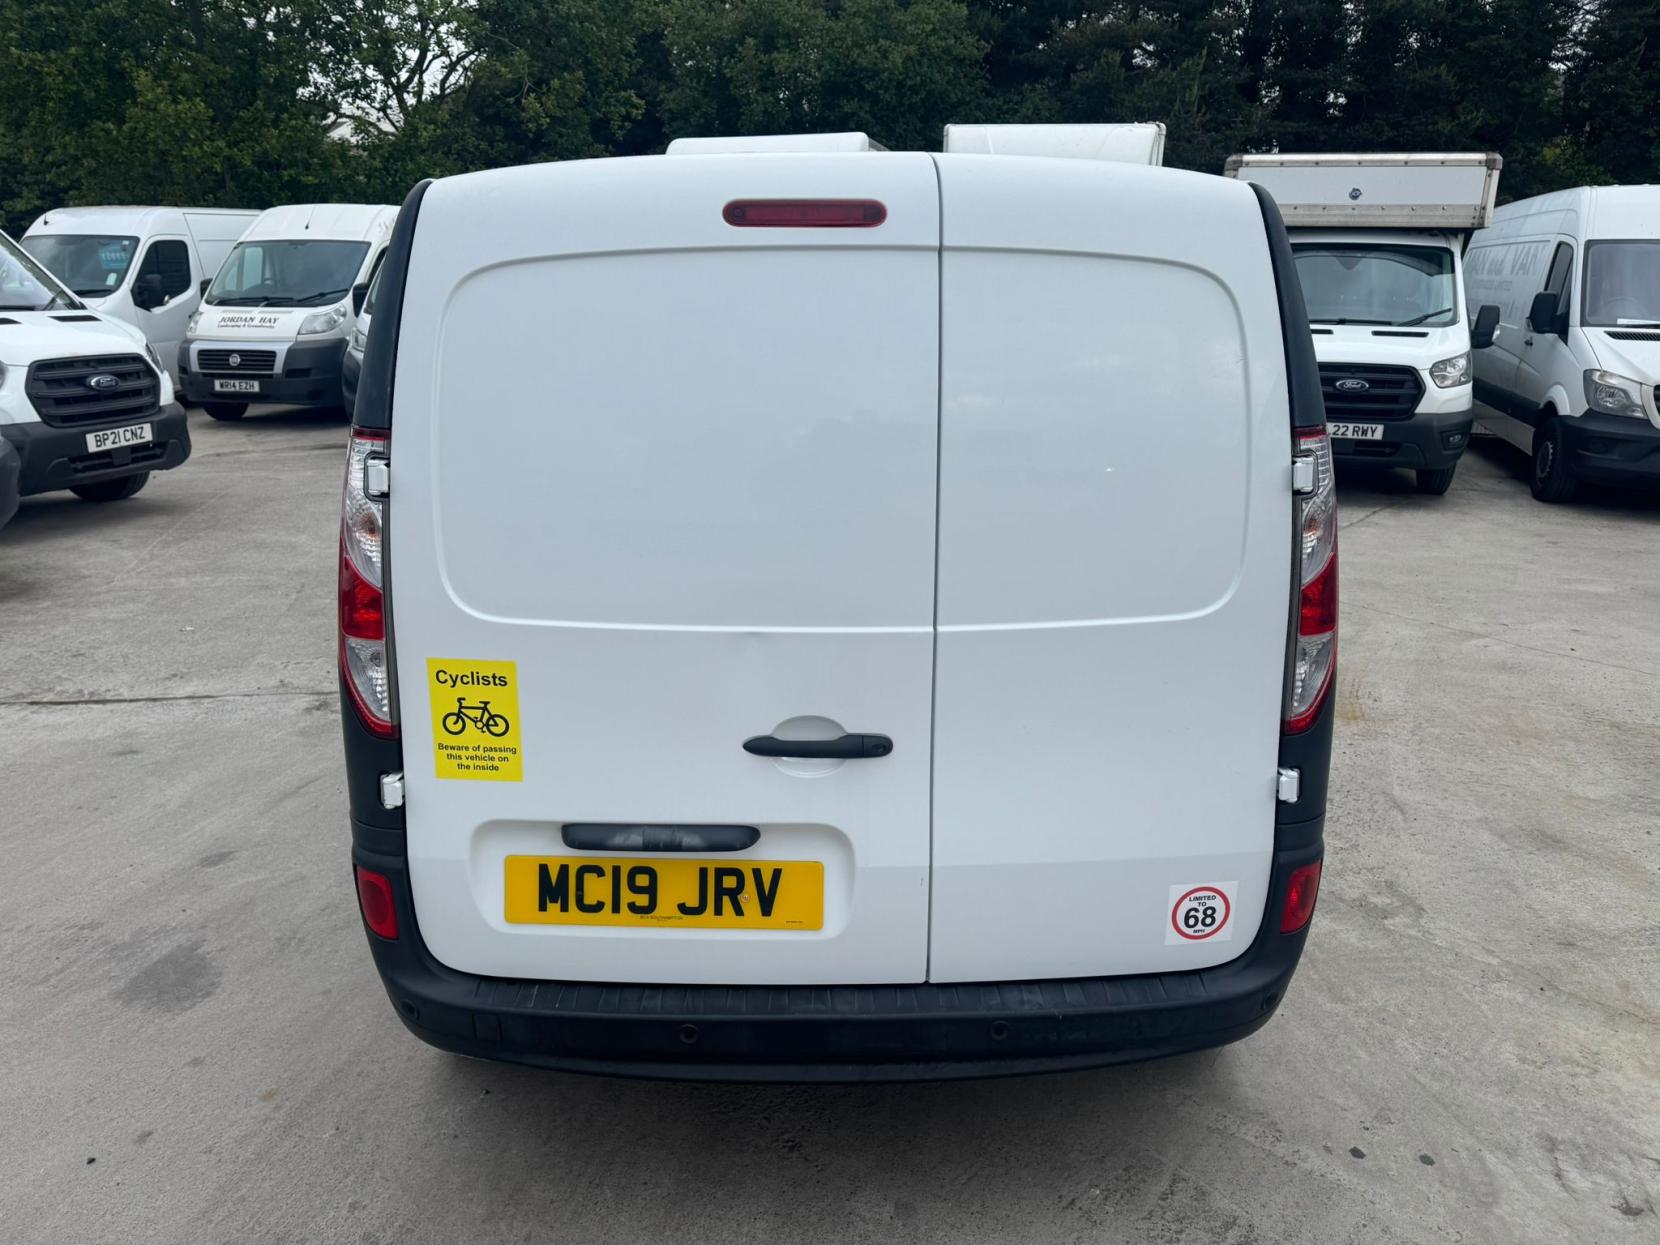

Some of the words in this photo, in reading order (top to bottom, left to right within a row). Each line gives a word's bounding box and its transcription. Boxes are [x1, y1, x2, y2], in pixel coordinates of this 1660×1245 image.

[259, 316, 280, 324] HAY
[94, 430, 121, 448] BP21
[123, 426, 145, 442] CNZ
[1328, 424, 1349, 437] 22
[1352, 425, 1378, 438] RWY
[435, 669, 508, 688] Cyclists
[437, 742, 470, 752] Beware
[472, 744, 481, 752] of
[483, 745, 517, 754] passing
[446, 753, 462, 761] this
[465, 753, 496, 762] vehicle
[457, 762, 470, 770] the
[473, 763, 499, 771] inside
[538, 863, 658, 914] MC19
[677, 867, 783, 917] JRV
[1184, 906, 1216, 929] 68
